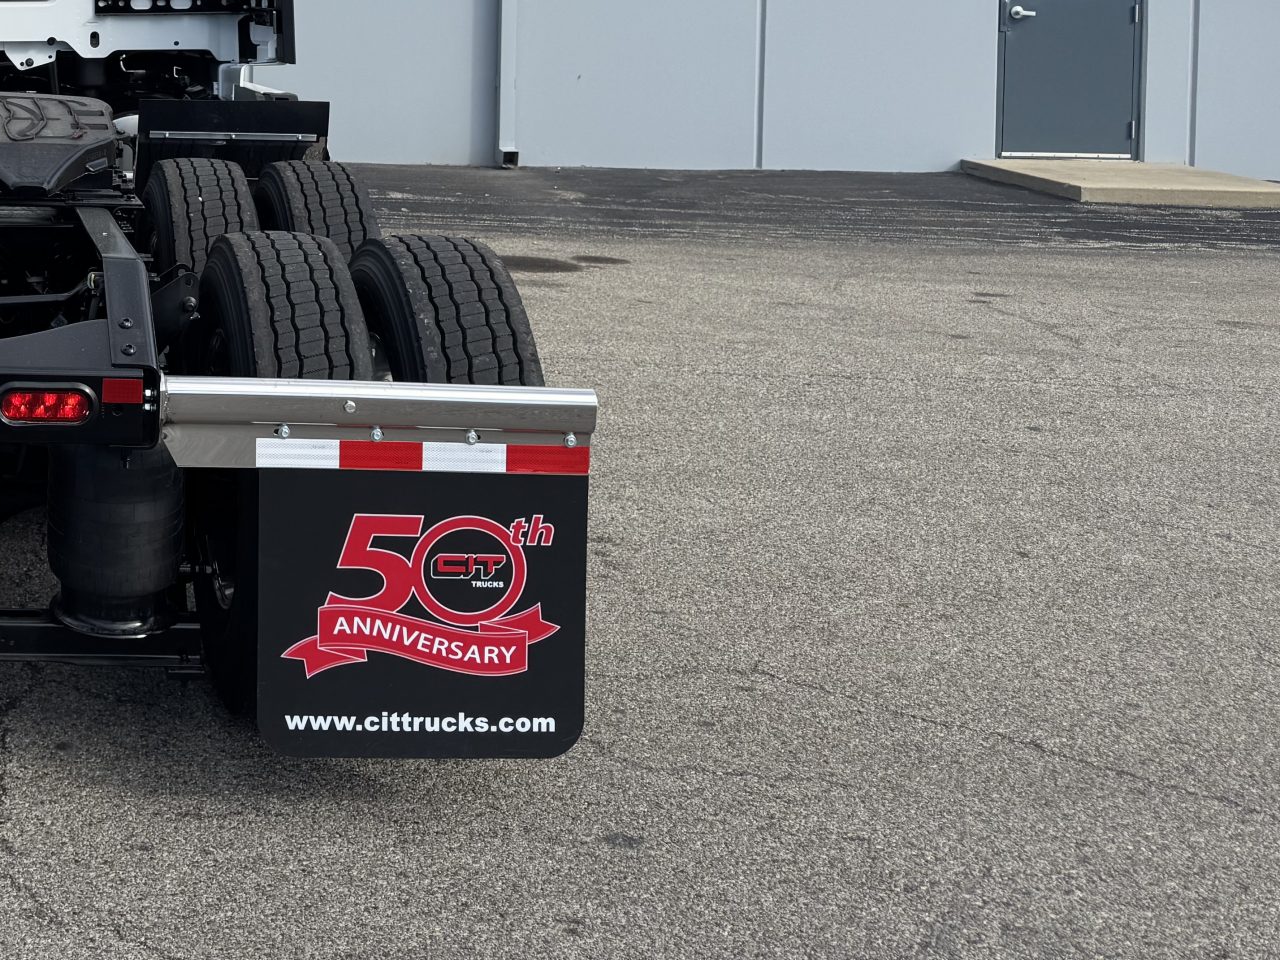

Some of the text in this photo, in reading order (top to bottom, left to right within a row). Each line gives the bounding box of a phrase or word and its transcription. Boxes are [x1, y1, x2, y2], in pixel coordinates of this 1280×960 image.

[324, 513, 555, 626] 50th
[431, 553, 506, 579] CIT
[333, 616, 517, 664] ANNIVERSARY
[285, 711, 556, 733] www.cittrucks.com
